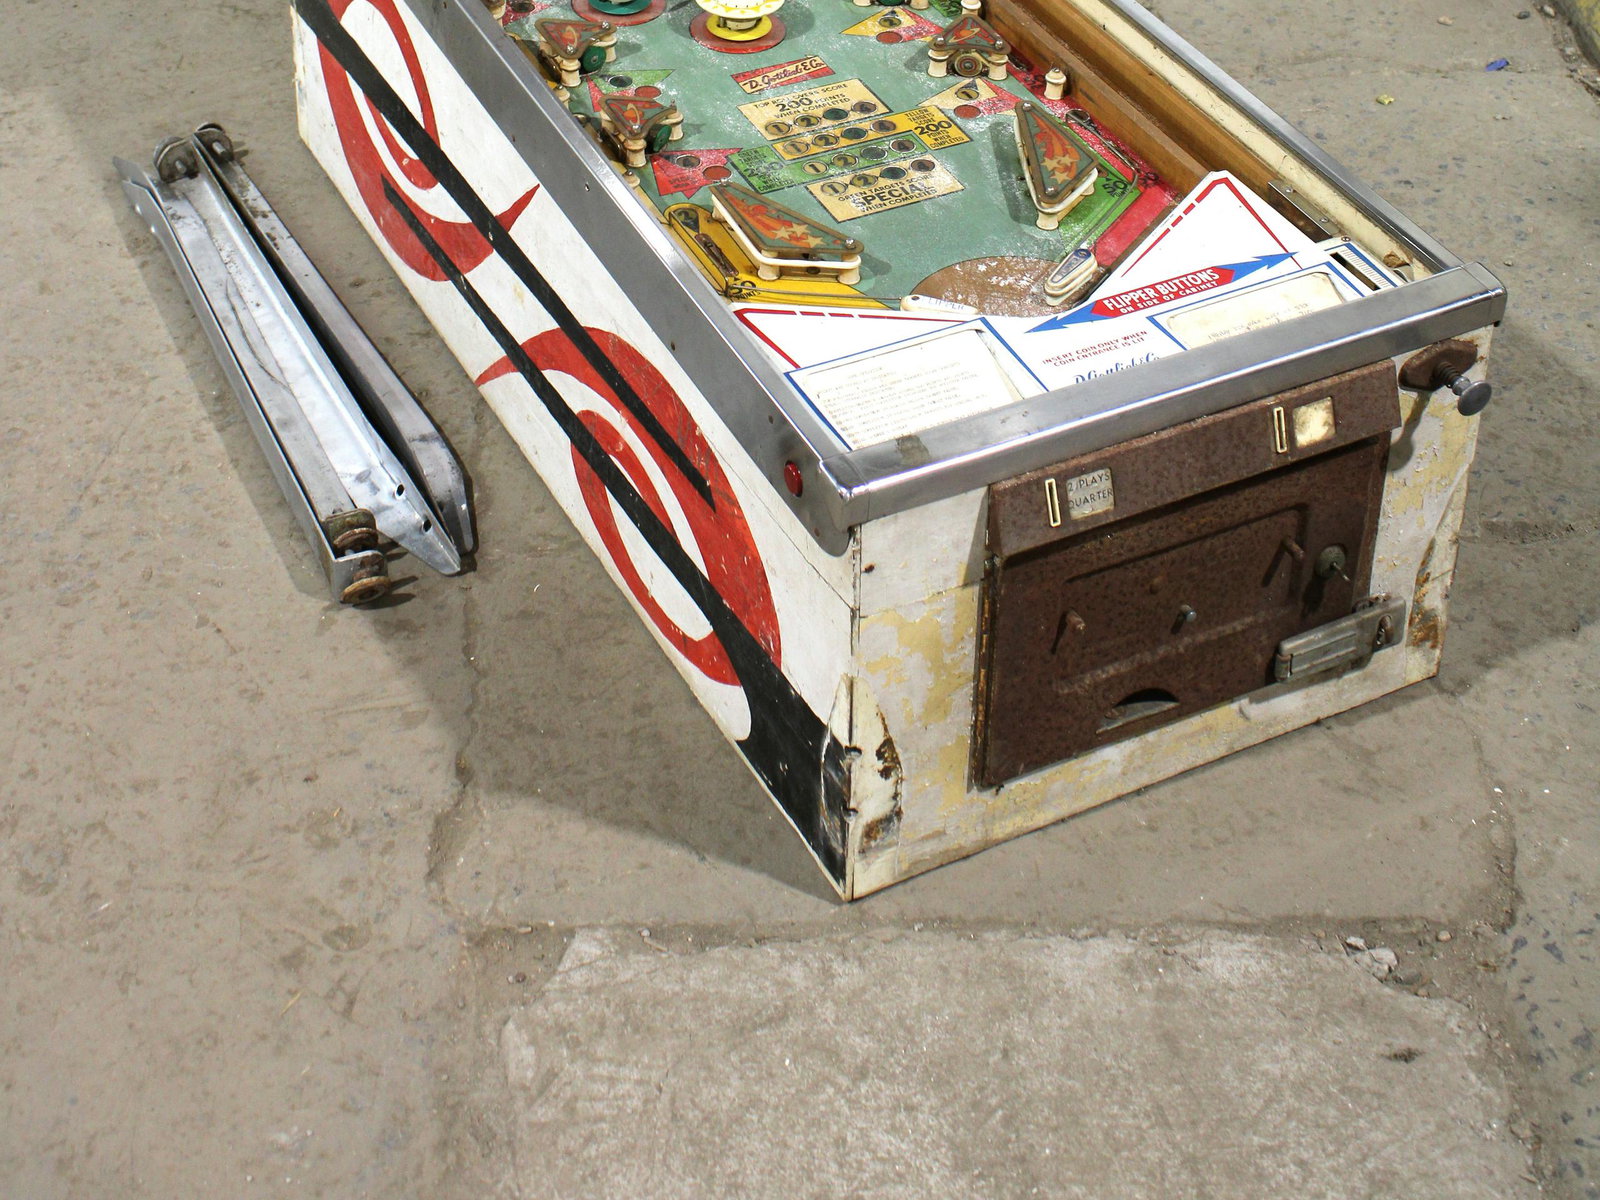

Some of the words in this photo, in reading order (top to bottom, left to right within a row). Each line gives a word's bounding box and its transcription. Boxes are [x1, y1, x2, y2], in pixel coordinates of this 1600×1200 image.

[762, 64, 802, 87] Gottlieb
[754, 101, 770, 109] TOP
[821, 83, 849, 93] SCORE
[775, 97, 813, 113] 200
[775, 109, 801, 119] WHEN
[802, 98, 851, 112] COMPLETED
[914, 120, 953, 135] 200
[838, 191, 867, 202] GREEN
[869, 181, 904, 193] TARGETS
[852, 182, 928, 208] SPECIAL
[1102, 180, 1128, 194] 50
[1102, 287, 1158, 311] FLIPPER
[1158, 269, 1221, 295] BUTTONS
[1119, 305, 1134, 314] ON
[1135, 298, 1158, 310] SIDE
[1163, 292, 1177, 301] OF
[1178, 281, 1218, 296] CABINET
[1042, 351, 1073, 365] INSERT
[1075, 345, 1096, 355] COIN
[1096, 338, 1120, 349] ONLY
[1121, 330, 1148, 342] WHEN
[1053, 357, 1074, 367] COIN
[1076, 345, 1119, 361] ENTRANCE
[1121, 340, 1131, 348] IS
[1131, 336, 1145, 345] LIT
[1067, 482, 1074, 492] 2
[1078, 473, 1110, 488] PLAYS
[1068, 487, 1114, 510] QUARTER
